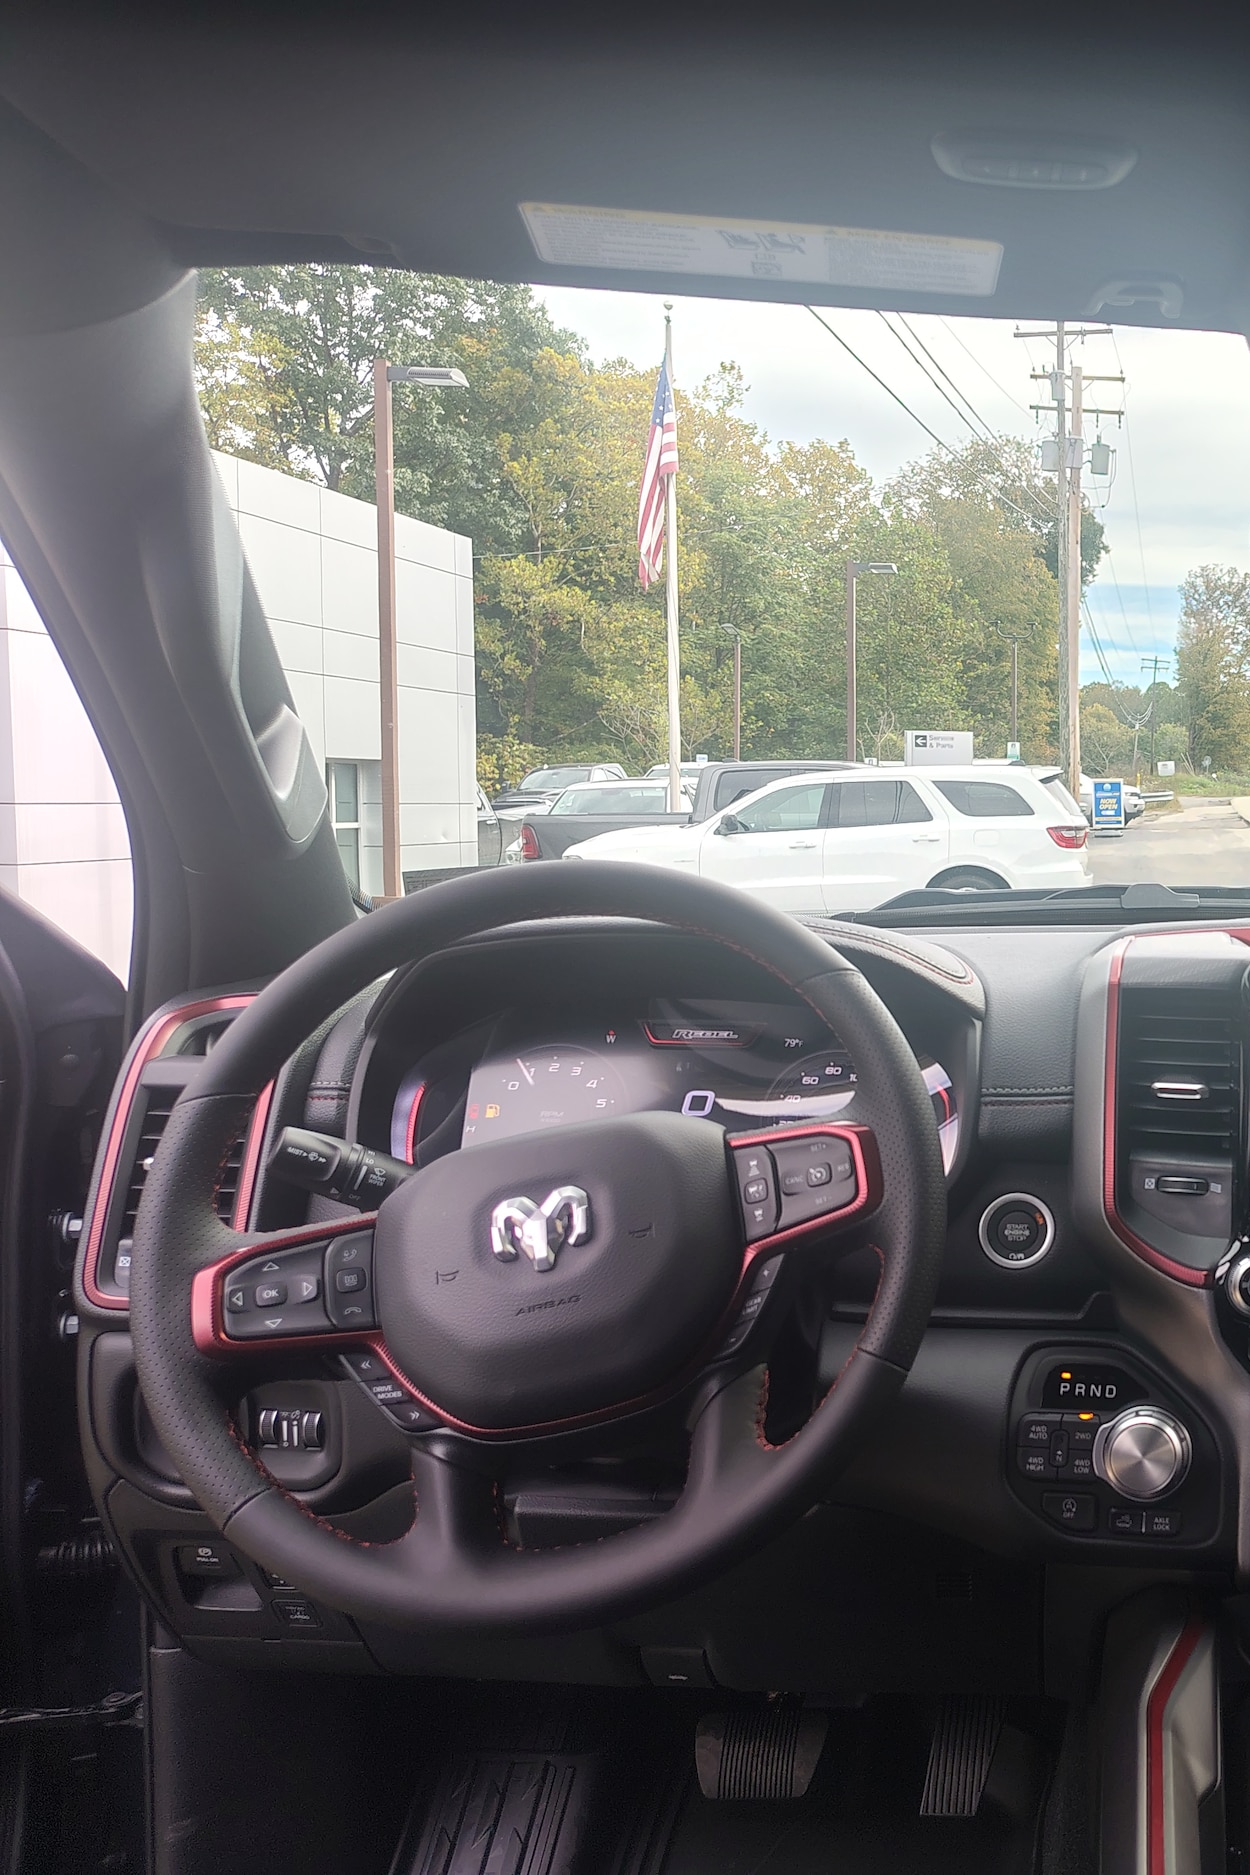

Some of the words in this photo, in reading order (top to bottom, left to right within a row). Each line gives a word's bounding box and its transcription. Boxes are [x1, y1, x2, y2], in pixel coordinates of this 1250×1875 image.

[606, 1034, 616, 1044] W
[528, 1067, 536, 1077] 1
[548, 1063, 560, 1072] 2
[570, 1066, 582, 1076] 3
[825, 1066, 842, 1075] 80
[586, 1079, 598, 1089] 4
[801, 1076, 819, 1085] 60
[507, 1081, 520, 1091] 0
[595, 1098, 608, 1108] 5
[681, 1090, 716, 1117] 0
[784, 1095, 801, 1104] 40
[287, 1146, 304, 1157] MIST
[365, 1157, 375, 1165] LO
[368, 1178, 384, 1187] WIPER
[369, 1173, 387, 1183] FRONT
[264, 1288, 279, 1298] OK
[515, 1294, 582, 1316] AIRBAG
[372, 1384, 393, 1392] DRIVE
[1060, 1383, 1071, 1396] P
[1075, 1383, 1086, 1397] R
[1090, 1384, 1101, 1398] N
[1105, 1385, 1117, 1399] D
[377, 1390, 403, 1400] MODES
[1030, 1425, 1047, 1433] 4WD
[1029, 1432, 1048, 1440] AUTO
[1074, 1432, 1092, 1440] 2WD
[1027, 1456, 1044, 1465] 4WD
[1074, 1459, 1091, 1467] 4WD
[1026, 1463, 1044, 1471] HIGH
[1073, 1466, 1090, 1474] LOW
[1062, 1511, 1075, 1519] OFF
[1154, 1516, 1170, 1524] AXLE
